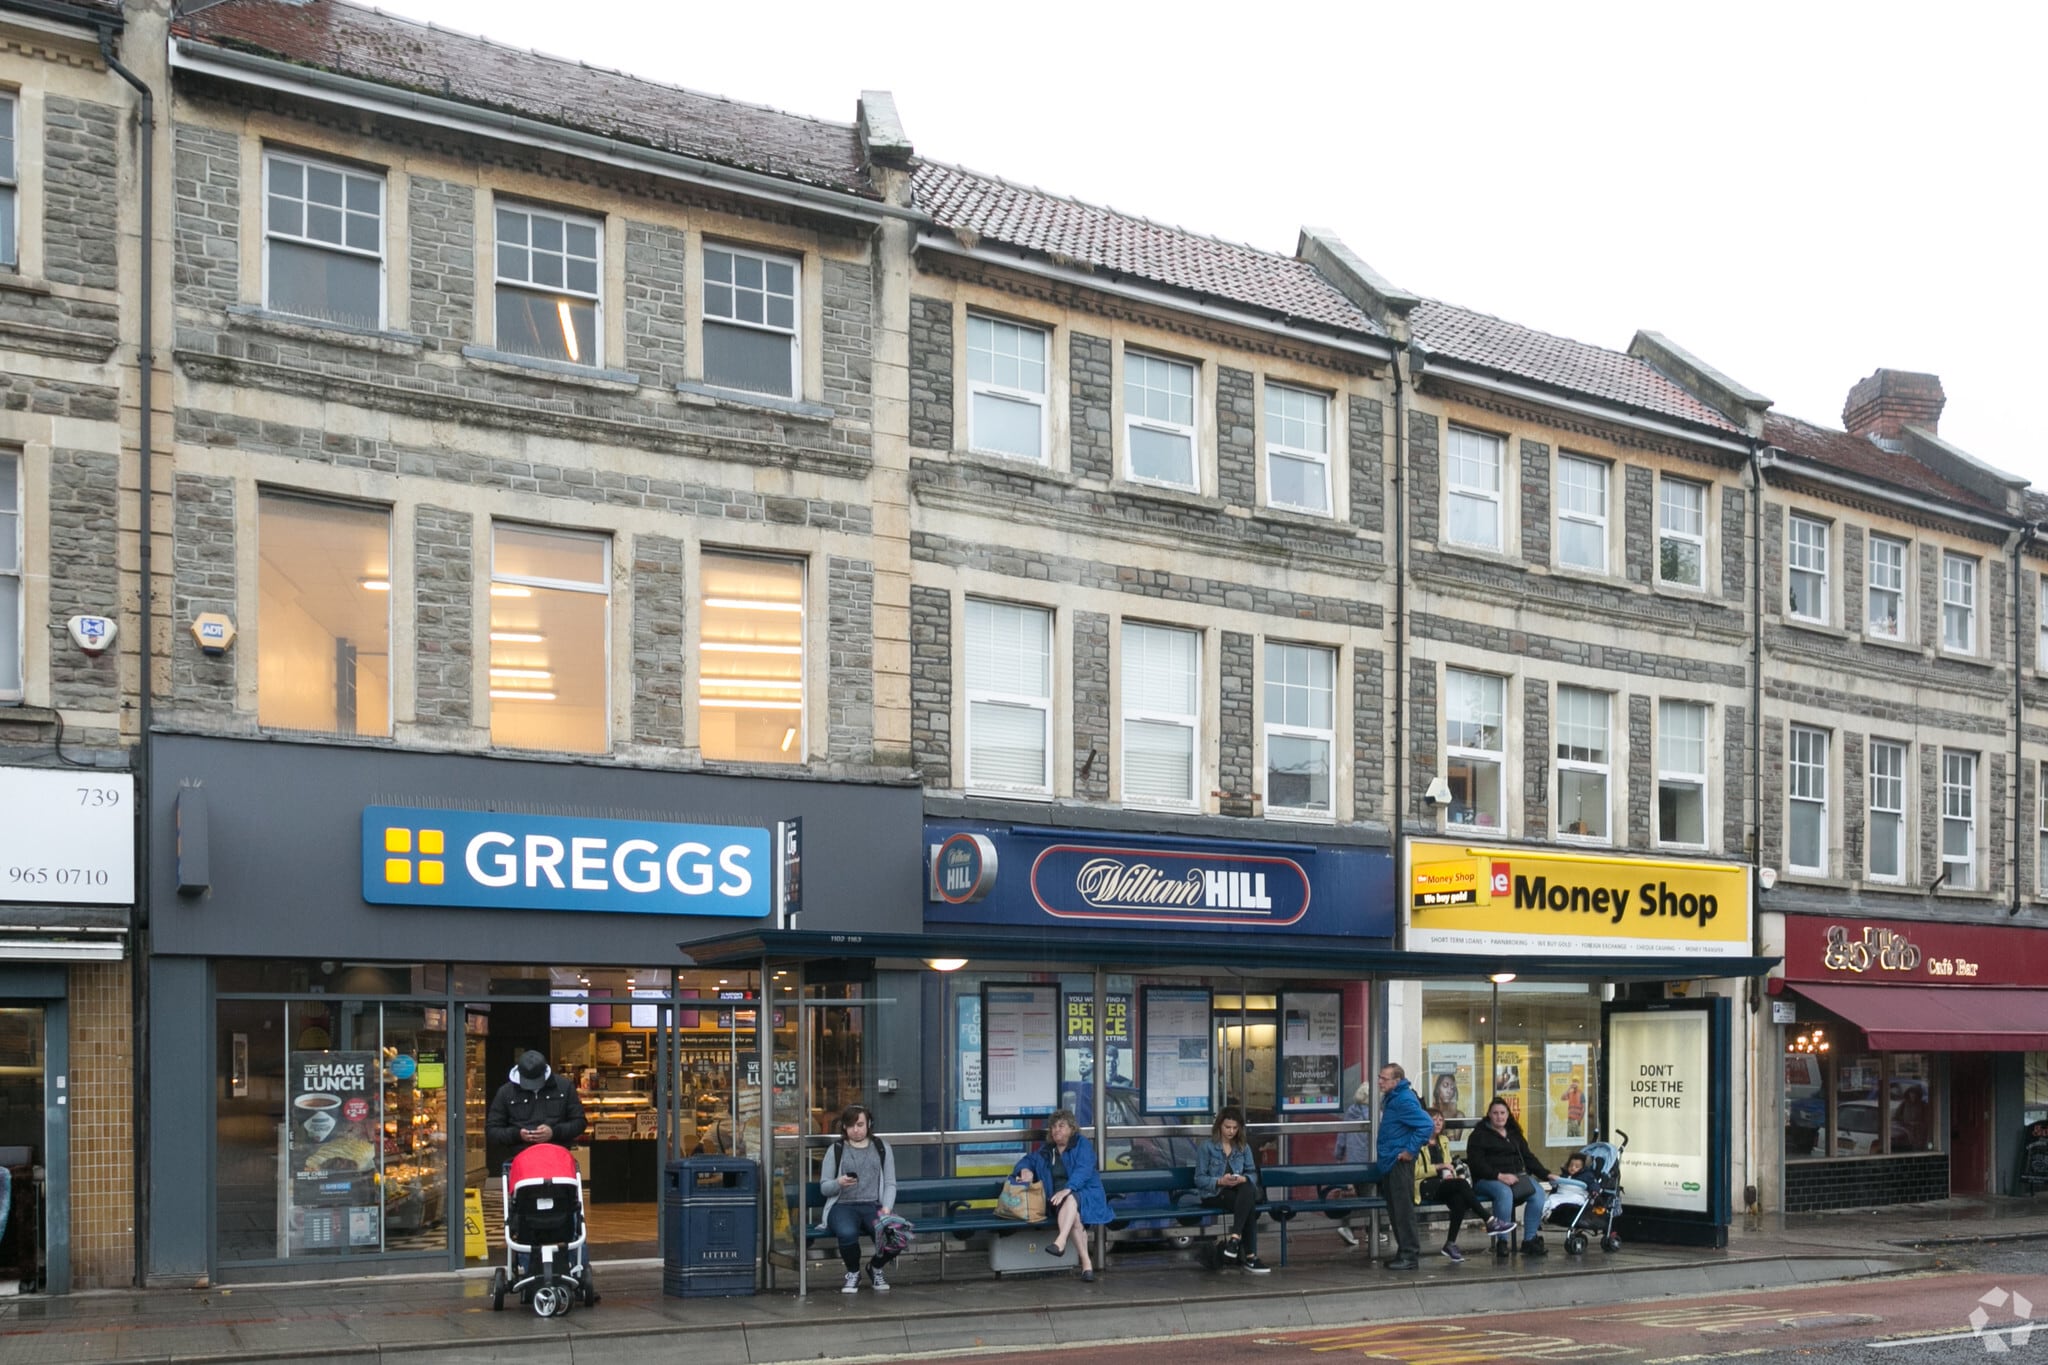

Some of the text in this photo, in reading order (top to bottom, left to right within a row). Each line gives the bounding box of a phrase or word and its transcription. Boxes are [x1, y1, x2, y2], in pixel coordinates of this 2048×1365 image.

[203, 625, 224, 635] ADT
[77, 788, 119, 807] 739
[465, 831, 752, 897] GREGGS
[9, 867, 108, 885] 965 0710
[947, 866, 971, 890] HILL
[1427, 876, 1453, 884] Money
[1455, 873, 1475, 883] Shop
[1077, 858, 1272, 909] William HILL
[1424, 891, 1468, 904] We buy gold
[1514, 875, 1630, 924] Money
[1639, 881, 1718, 928] Shop
[1928, 958, 1979, 977] Café Bar
[1068, 1003, 1127, 1016] BETER
[1068, 1017, 1127, 1035] PRCE
[320, 1064, 364, 1076] MAKE
[1293, 1070, 1326, 1079] travelwest
[1640, 1064, 1674, 1076] DON'T
[303, 1077, 364, 1091] LUNCH
[747, 1072, 796, 1085] LUCH
[1630, 1080, 1684, 1093] LOSE THE
[1633, 1096, 1681, 1109] PICTURE
[703, 1251, 738, 1259] LITTER
[1251, 1323, 1644, 1365] STOP
